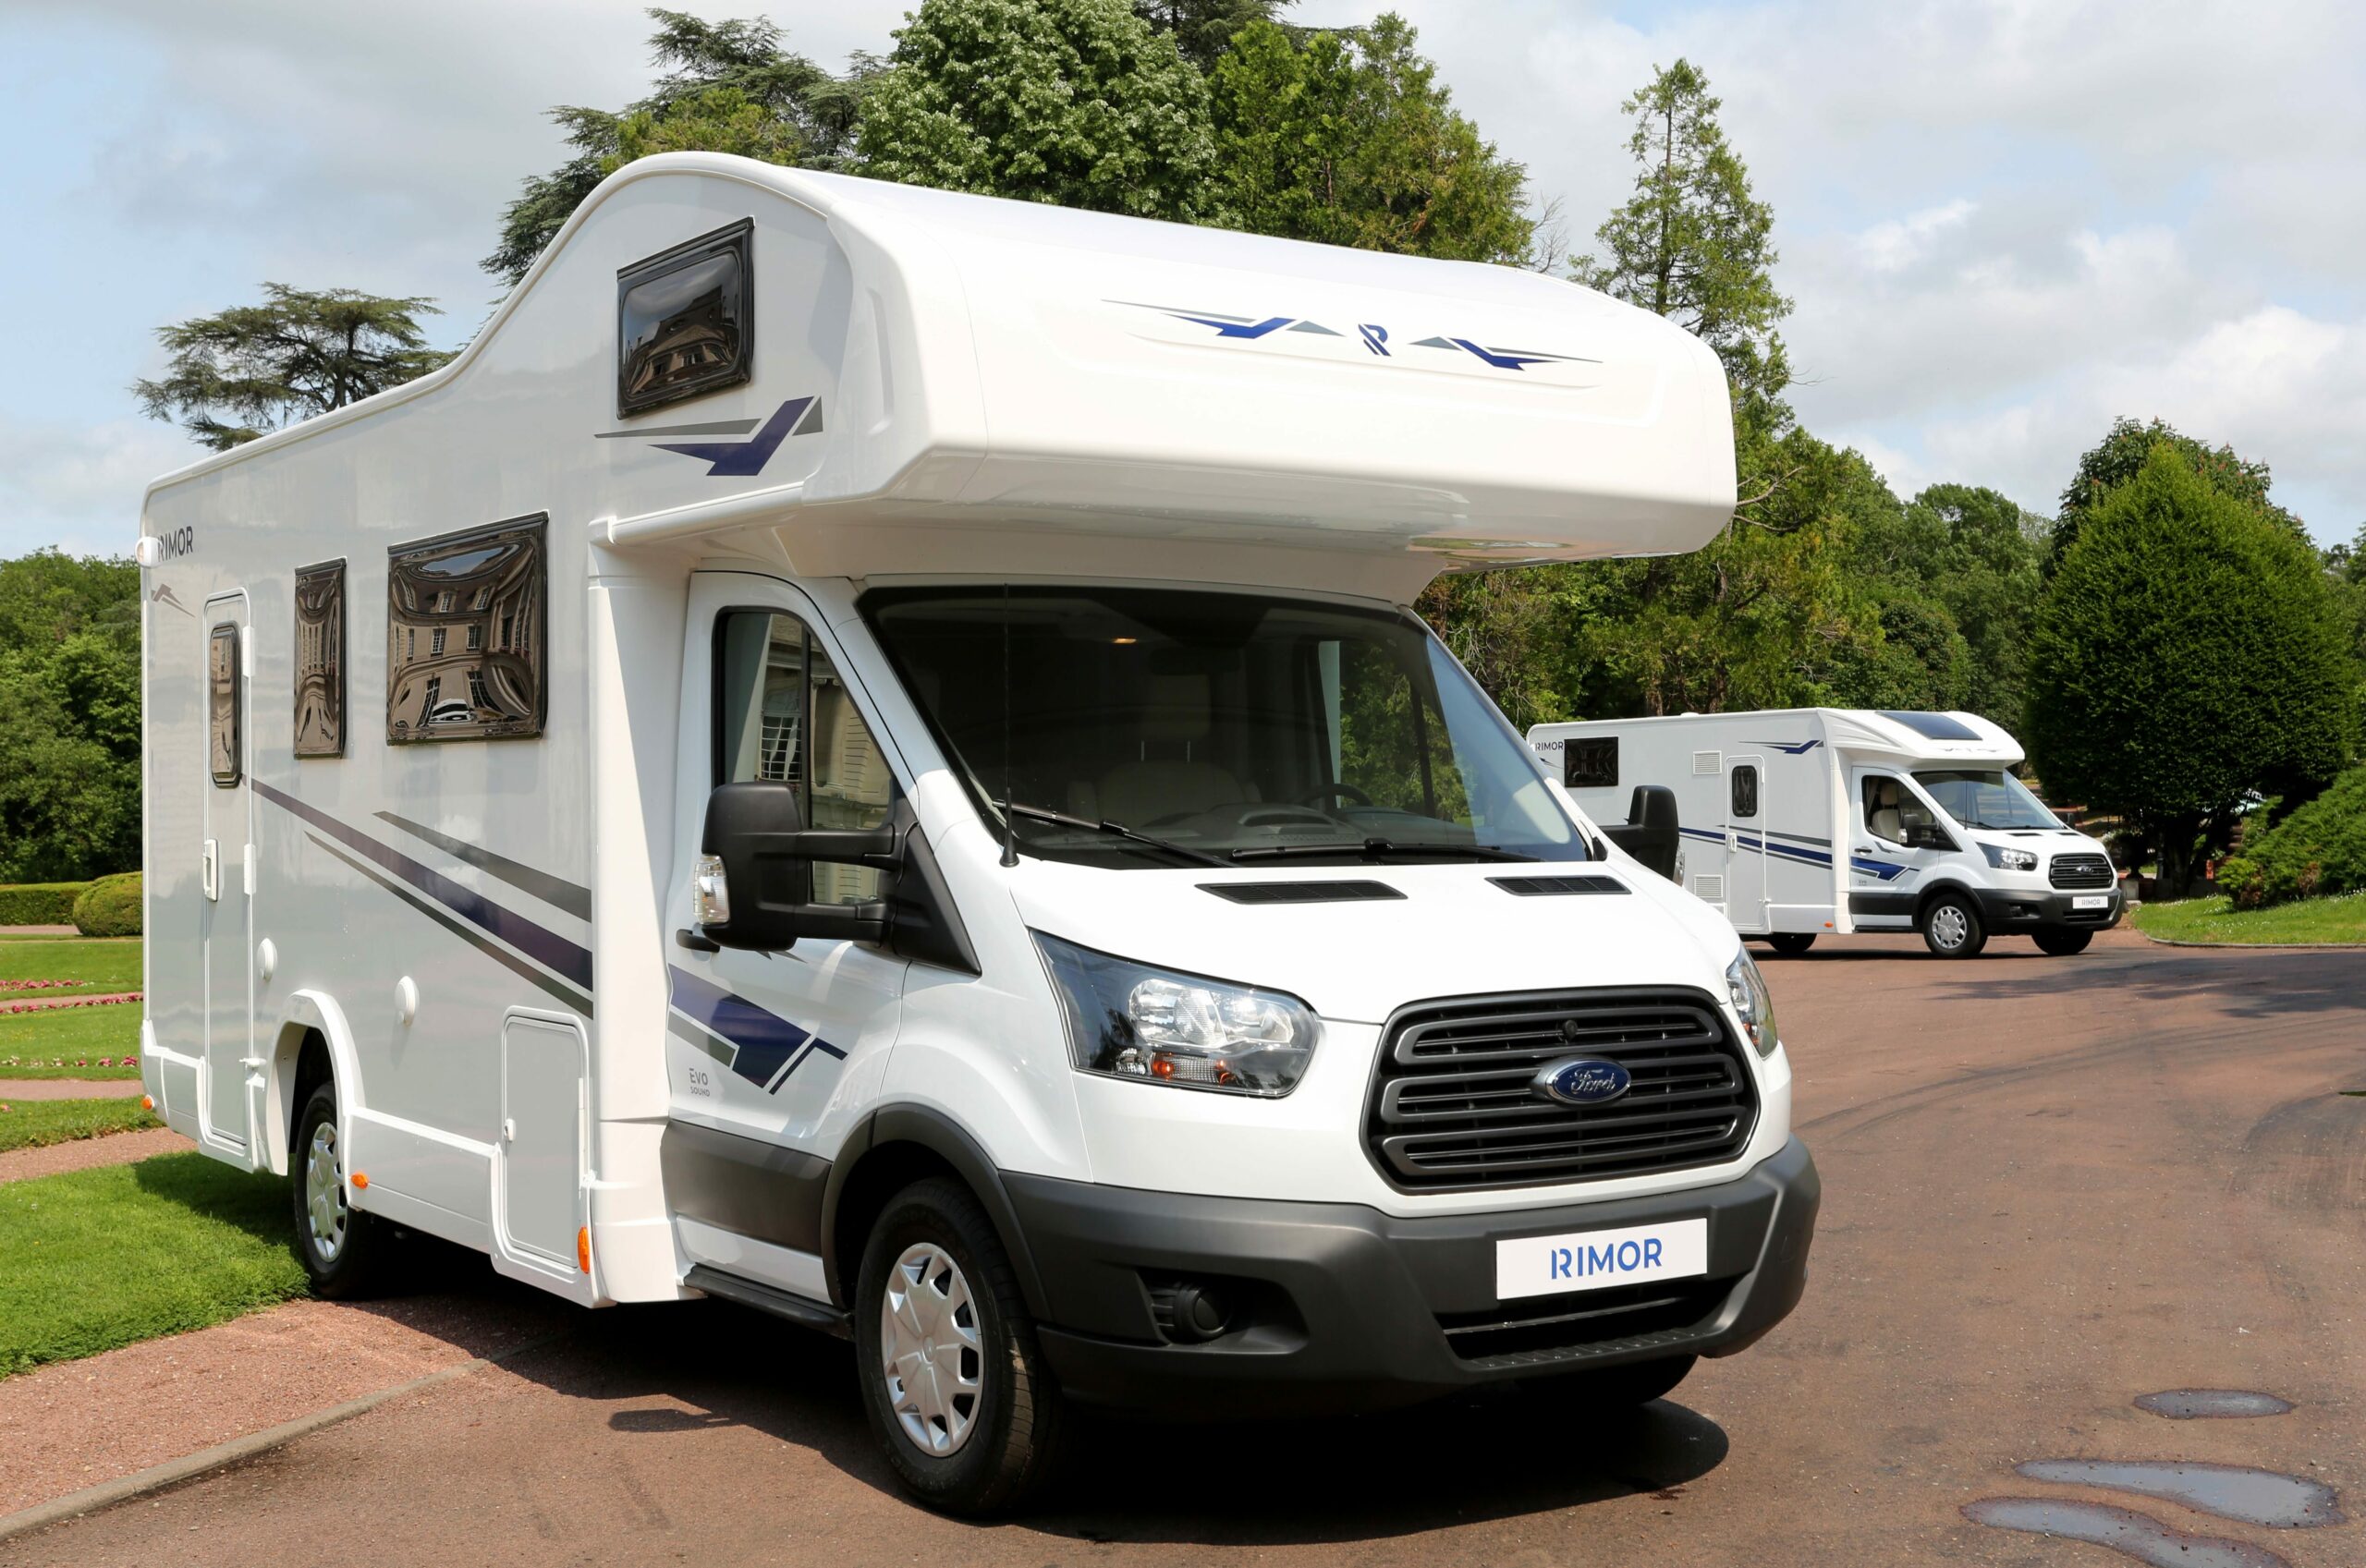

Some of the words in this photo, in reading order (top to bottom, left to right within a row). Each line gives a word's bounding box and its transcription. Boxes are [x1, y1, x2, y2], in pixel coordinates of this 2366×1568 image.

[157, 525, 193, 563] RIMOR
[1535, 741, 1564, 751] RIMOR
[1570, 1068, 1616, 1094] Ford
[1551, 1237, 1663, 1280] RIMOR
